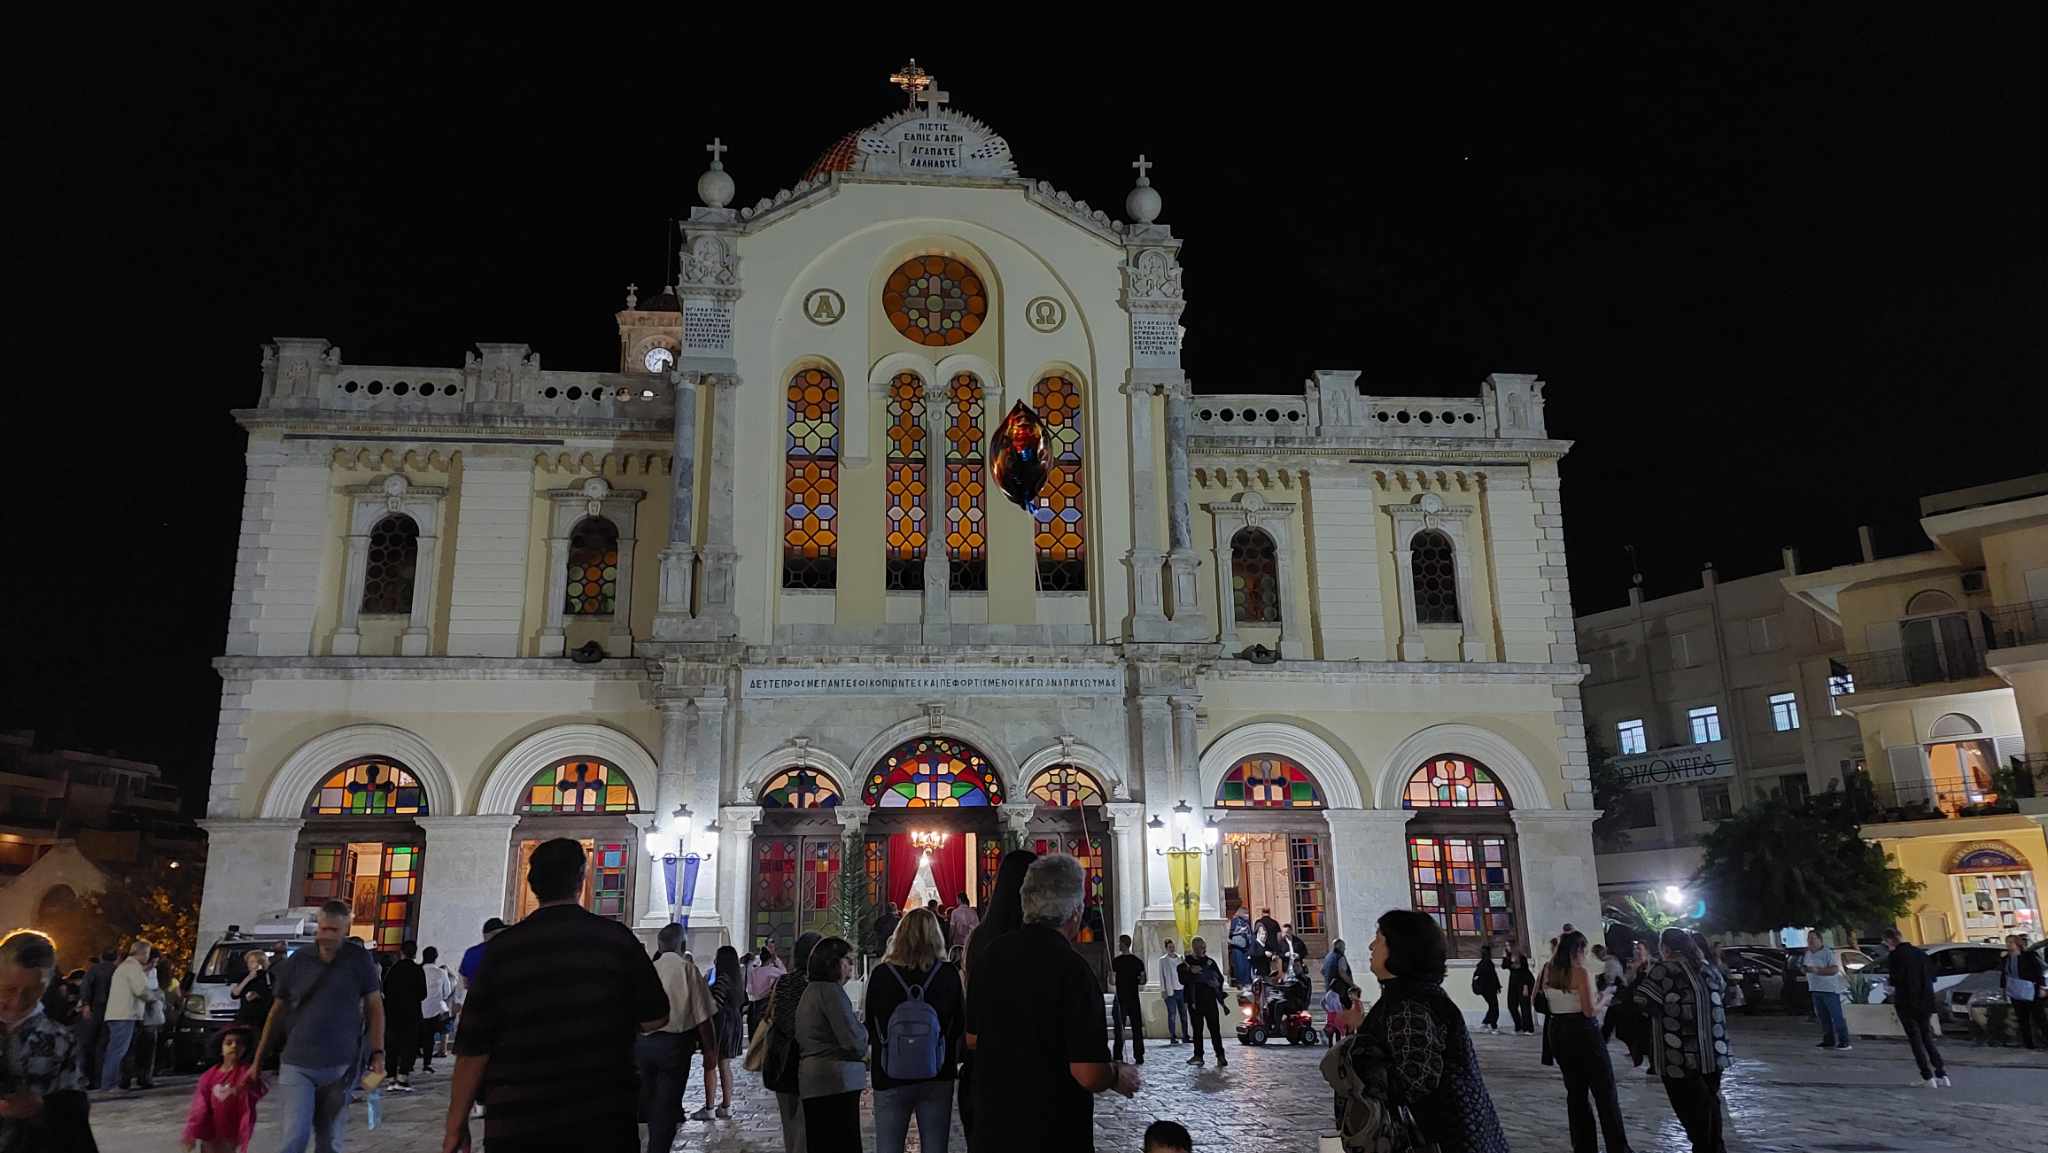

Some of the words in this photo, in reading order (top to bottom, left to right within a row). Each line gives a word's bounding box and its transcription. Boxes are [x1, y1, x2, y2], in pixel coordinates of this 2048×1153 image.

[920, 123, 948, 131] ΠΙΣΤΙΣ
[904, 133, 931, 142] ΕΛΠΙΣ
[934, 134, 963, 143] ΑΓΑΠΗ
[912, 146, 955, 155] ΑΓΑΠΑΤΕ
